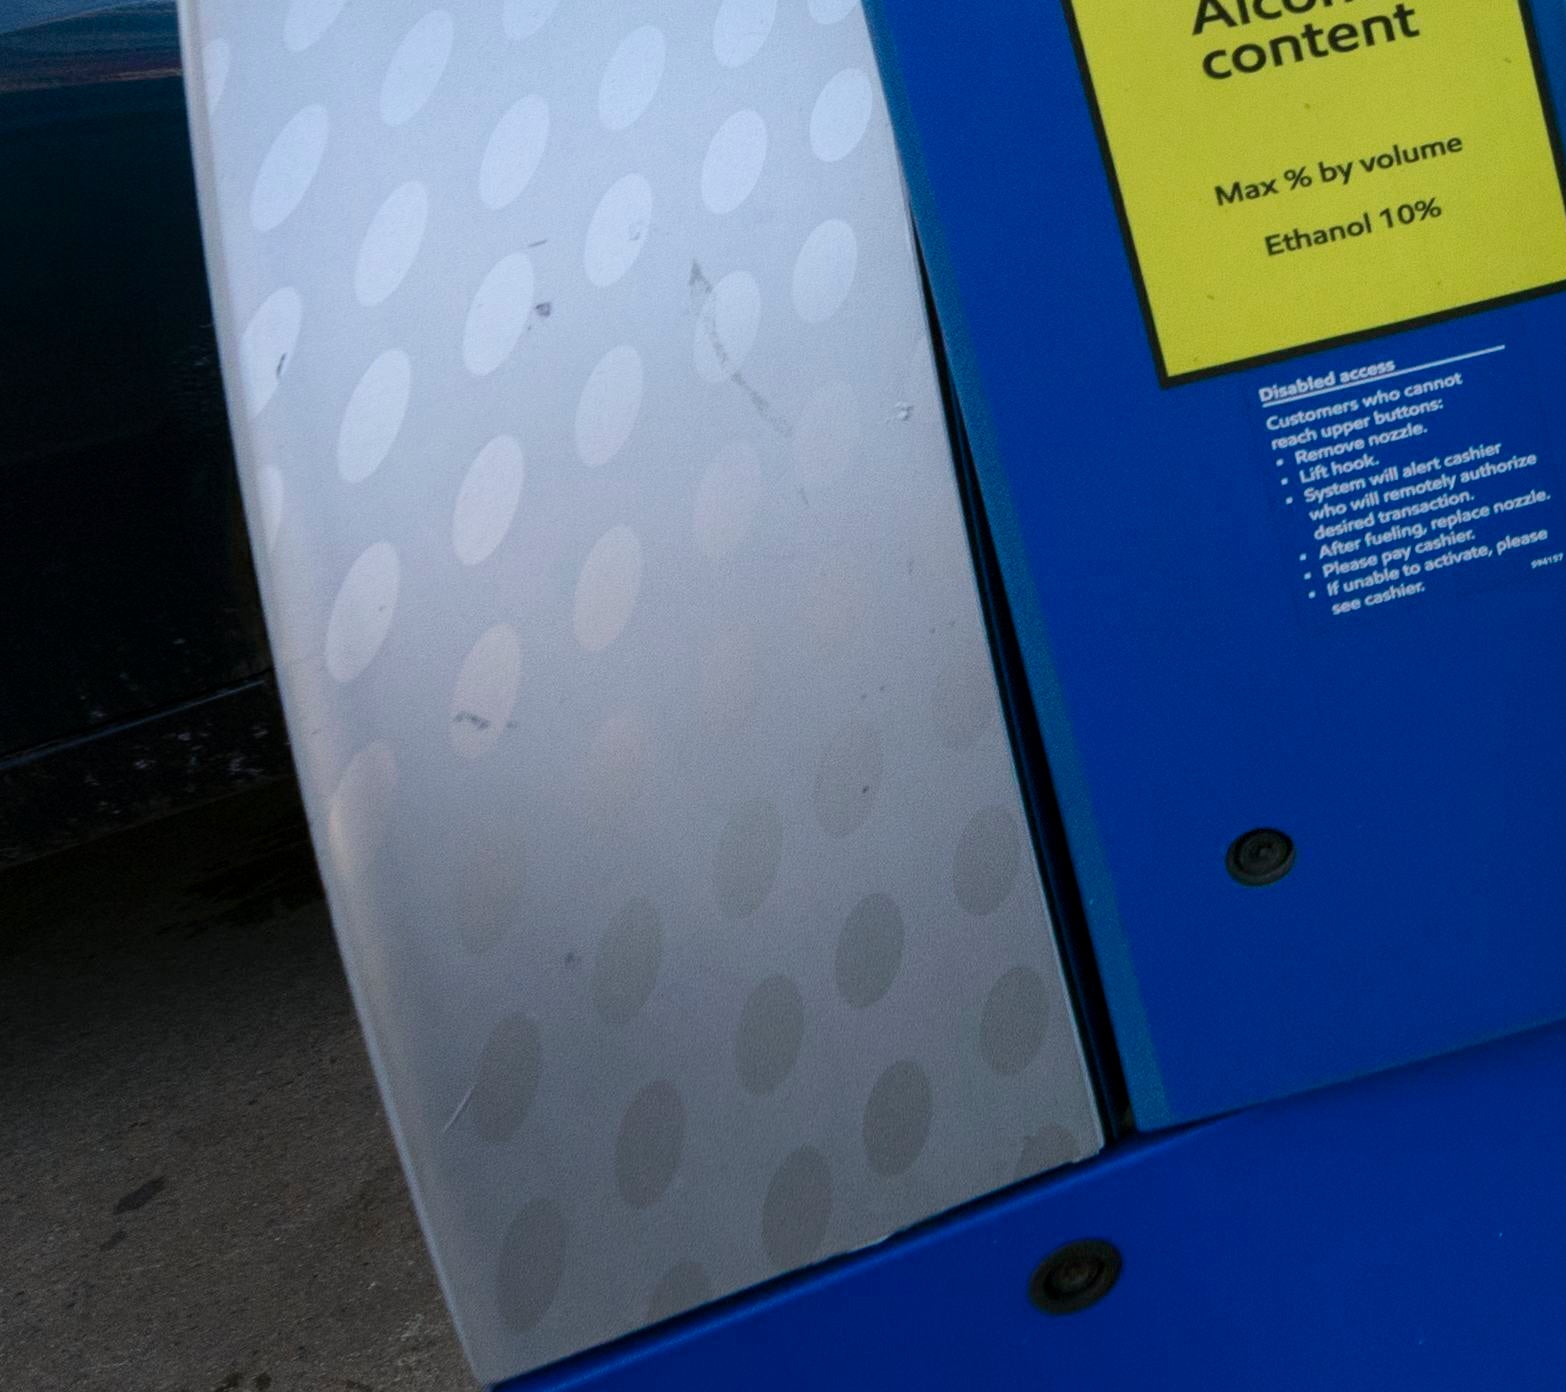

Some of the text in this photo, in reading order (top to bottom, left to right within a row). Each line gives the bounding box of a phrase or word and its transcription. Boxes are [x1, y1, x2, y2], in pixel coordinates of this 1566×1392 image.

[1202, 3, 1420, 80] content
[1214, 136, 1463, 208] Max % by volume
[1264, 196, 1443, 257] Ethanol 10%
[1258, 360, 1395, 402] Disabled access
[1266, 373, 1463, 431] Customers who cannot
[1271, 398, 1444, 450] reach upper buttons:
[1295, 421, 1428, 465] Remove nozzle.
[1299, 452, 1379, 483] Lift hook.
[1304, 442, 1502, 504] System will alert cashier
[1309, 453, 1537, 522] who will remotely authorize
[1314, 489, 1474, 541] desired transaction.
[1319, 488, 1550, 559] After fueling, replace nozzle.
[1322, 528, 1475, 578] Please pay cashier.
[1327, 528, 1548, 597] If unable to activate, please
[1332, 580, 1425, 616] see cashier.
